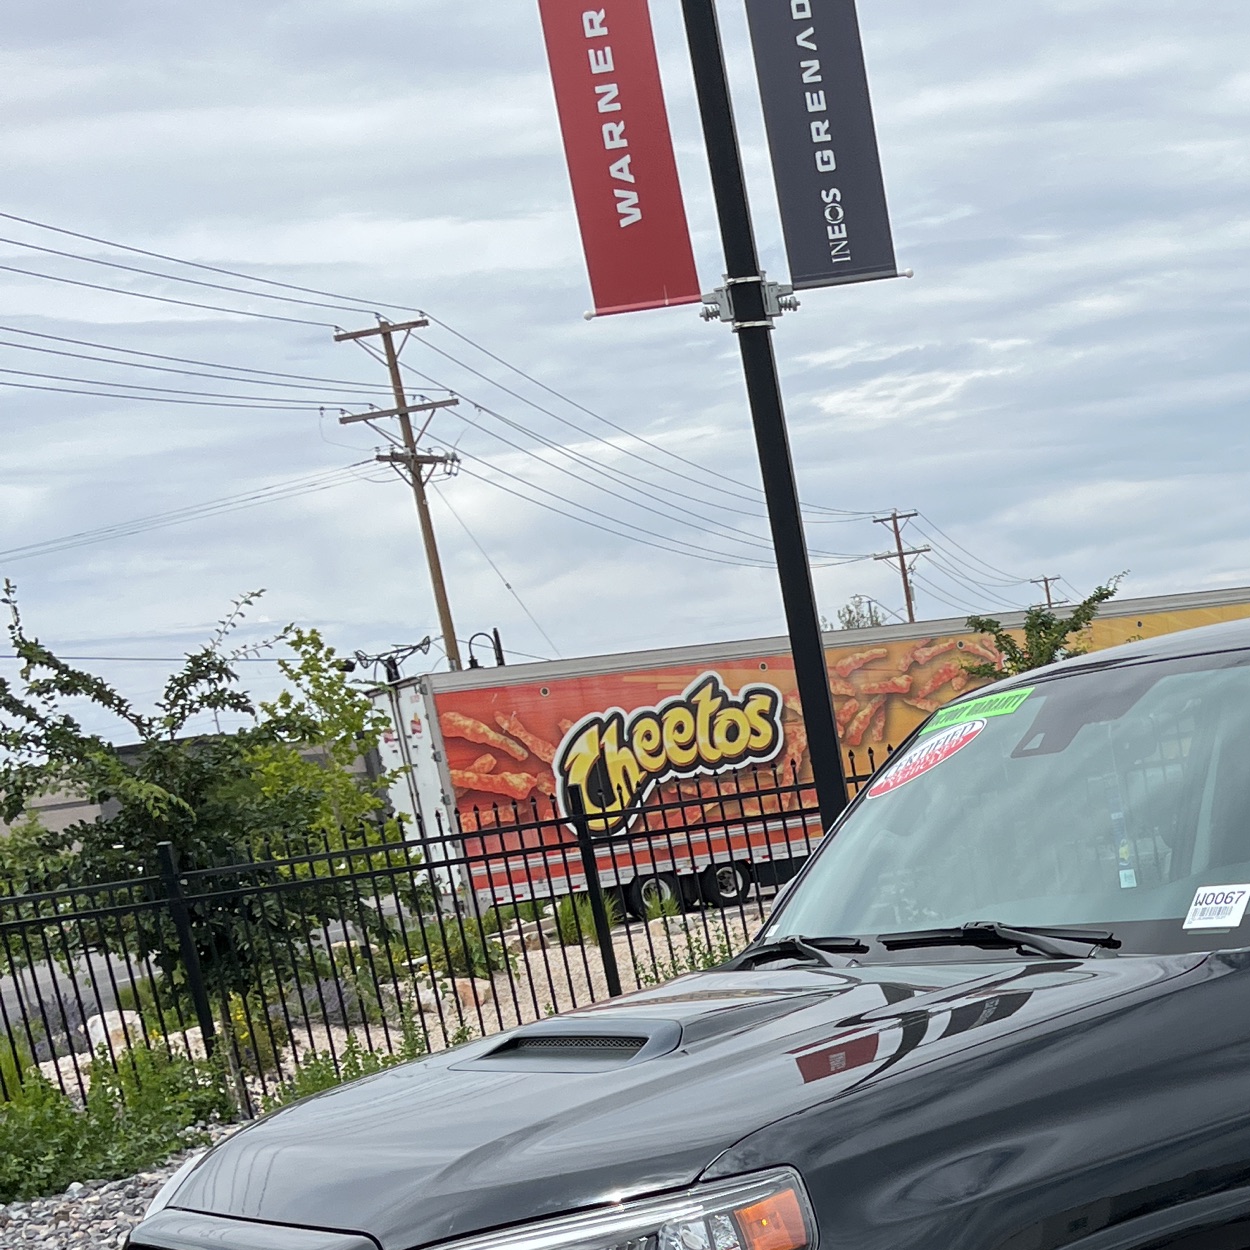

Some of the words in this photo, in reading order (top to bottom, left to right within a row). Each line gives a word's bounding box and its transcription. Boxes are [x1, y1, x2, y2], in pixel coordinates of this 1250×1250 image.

[581, 8, 643, 229] WARNER
[820, 186, 852, 264] INEOS
[563, 679, 776, 834] Cheetos
[884, 721, 976, 781] CERTIFIED
[1193, 890, 1247, 907] W0067
